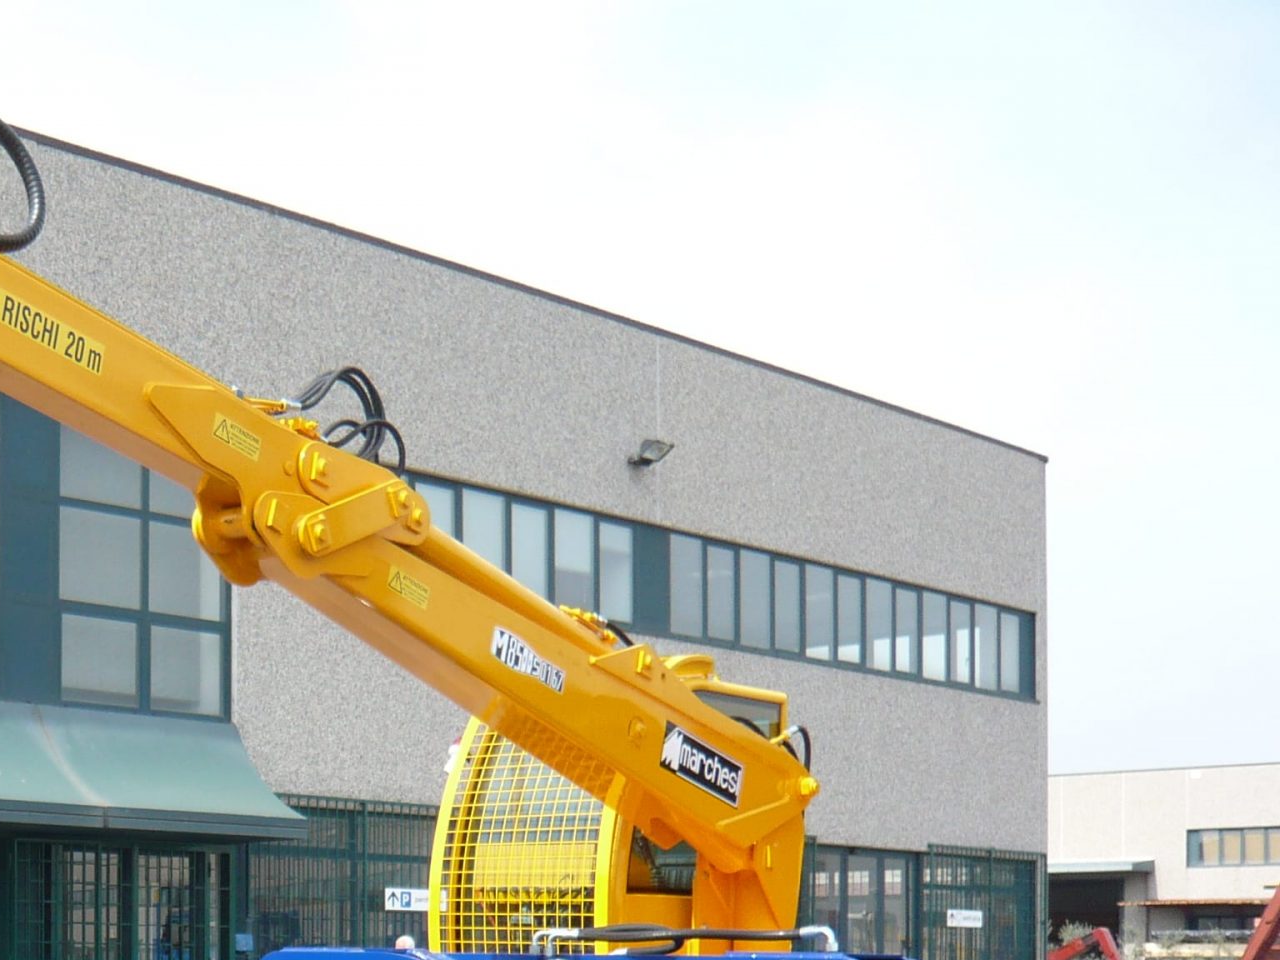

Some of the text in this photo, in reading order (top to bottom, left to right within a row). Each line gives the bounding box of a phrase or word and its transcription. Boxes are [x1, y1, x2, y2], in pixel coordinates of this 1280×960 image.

[1, 295, 60, 350] RISCHI
[64, 331, 85, 363] 20
[87, 348, 102, 374] m
